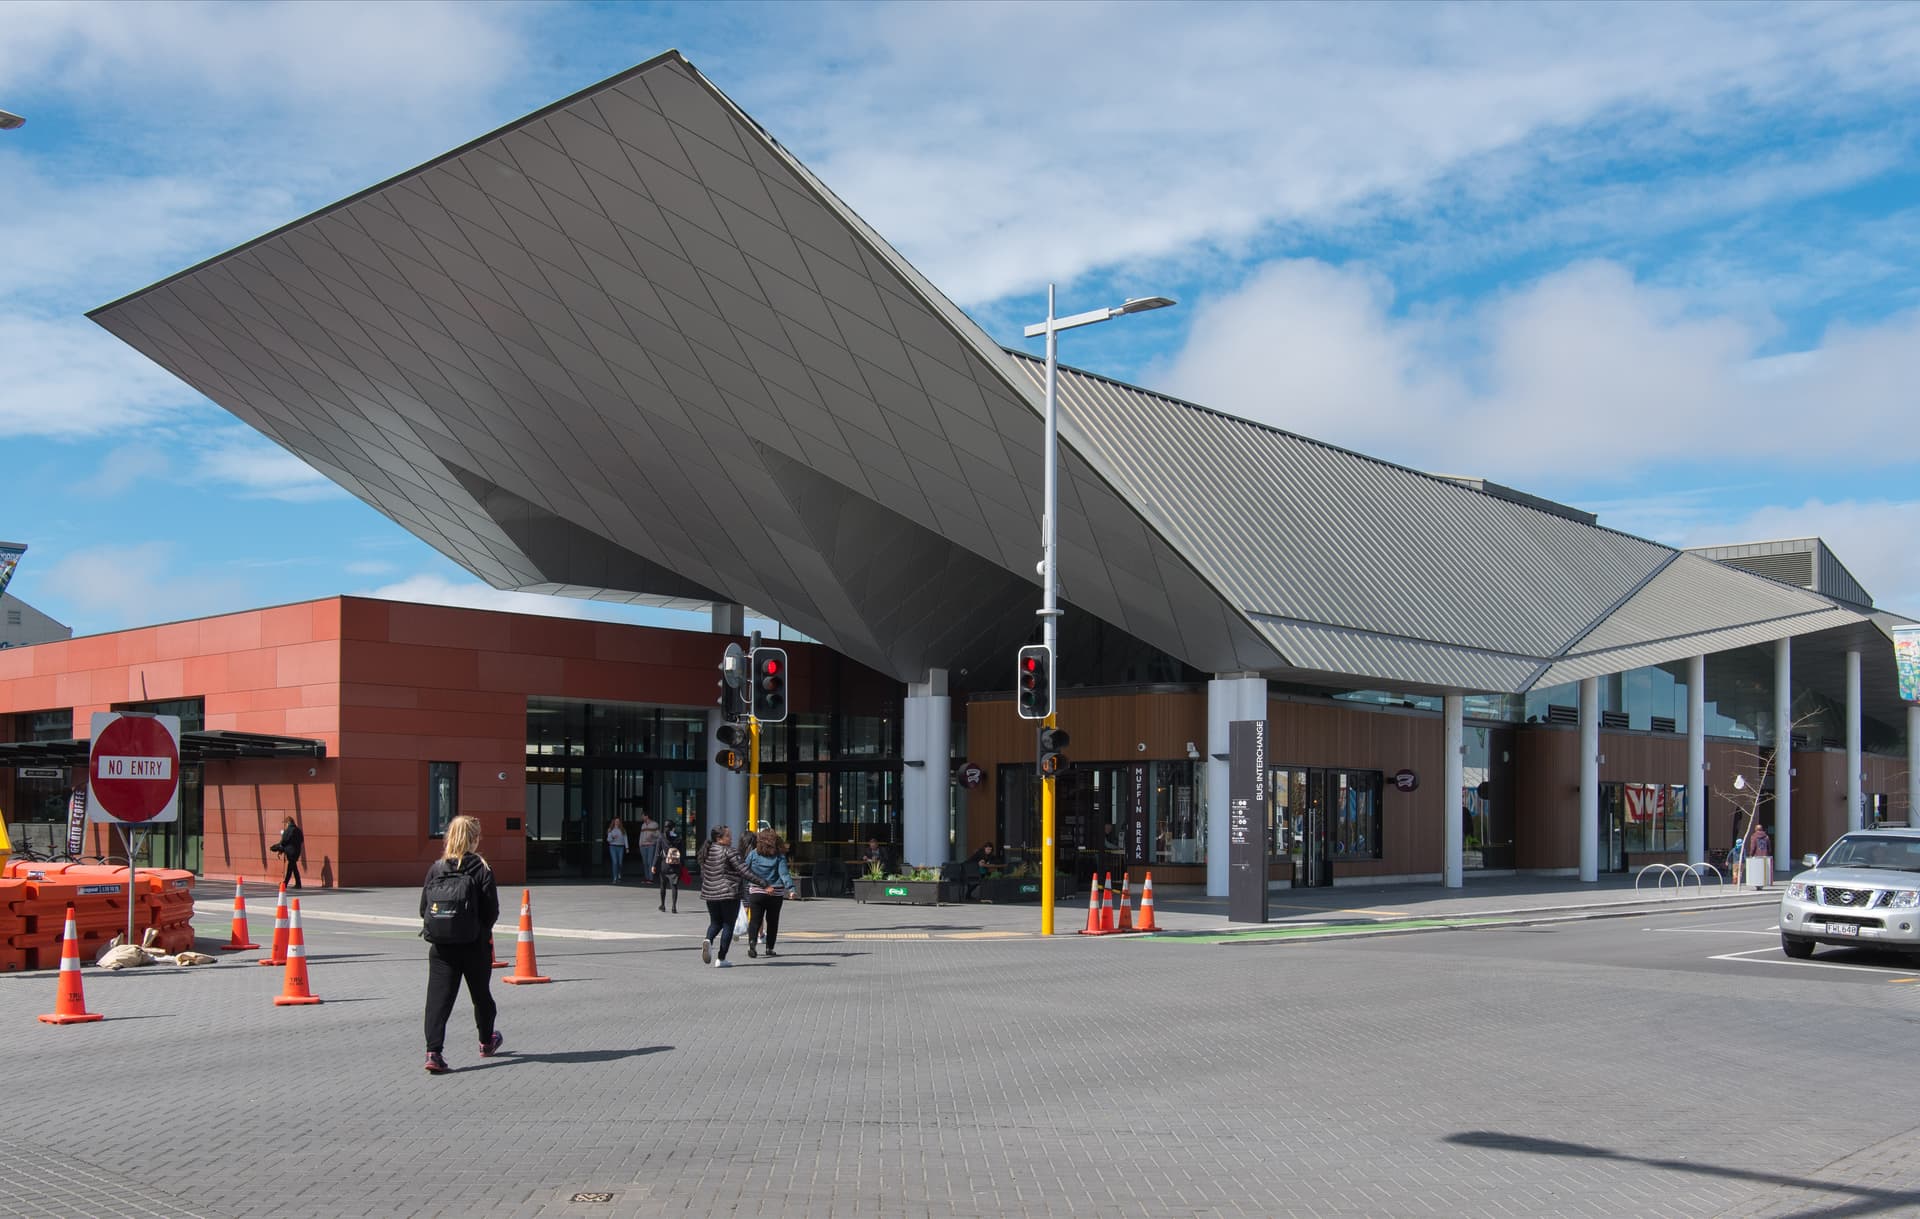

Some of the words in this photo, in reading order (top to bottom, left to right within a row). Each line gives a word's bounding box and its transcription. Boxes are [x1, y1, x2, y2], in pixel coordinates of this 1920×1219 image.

[1256, 721, 1264, 782] INTERCHANGE
[108, 760, 123, 775] NO
[131, 761, 162, 776] ENTRY
[1135, 768, 1143, 813] MUFFIN
[1256, 784, 1264, 801] BUS
[73, 791, 85, 819] COFFEE
[70, 826, 82, 853] GELATO
